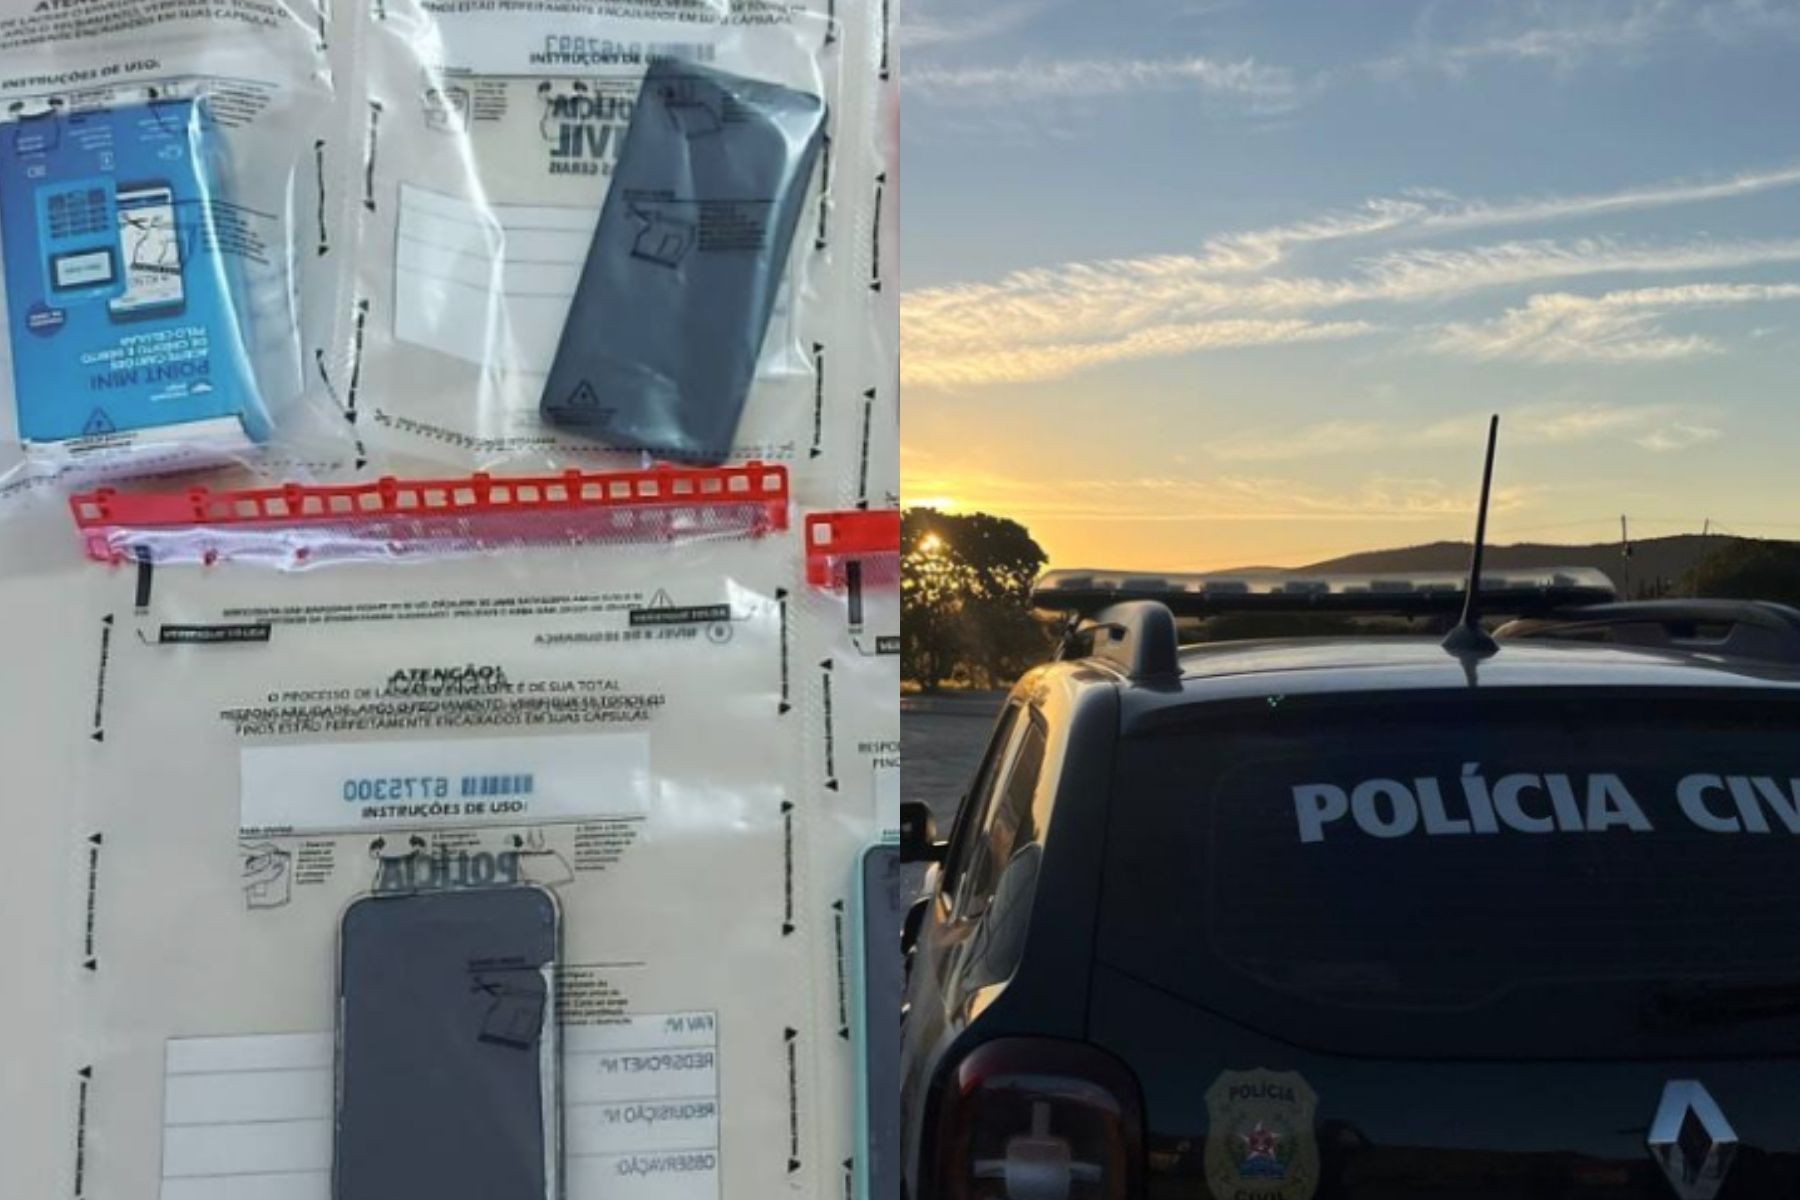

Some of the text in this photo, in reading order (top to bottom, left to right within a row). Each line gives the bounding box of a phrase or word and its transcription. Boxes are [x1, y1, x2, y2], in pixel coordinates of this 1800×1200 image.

[1, 69, 98, 91] INSTRUÇÕES
[100, 64, 120, 77] DE
[90, 360, 209, 391] POINT MINI
[391, 664, 503, 683] ATENÇÃO!
[282, 688, 350, 702] PROCESSO
[353, 687, 372, 699] DE
[529, 681, 546, 693] DE
[548, 680, 576, 693] SUA
[577, 678, 621, 693] TOTAL
[361, 801, 460, 820] INSTRUÇÕES
[464, 802, 485, 816] DE
[1292, 762, 1655, 843] POLÍCIA
